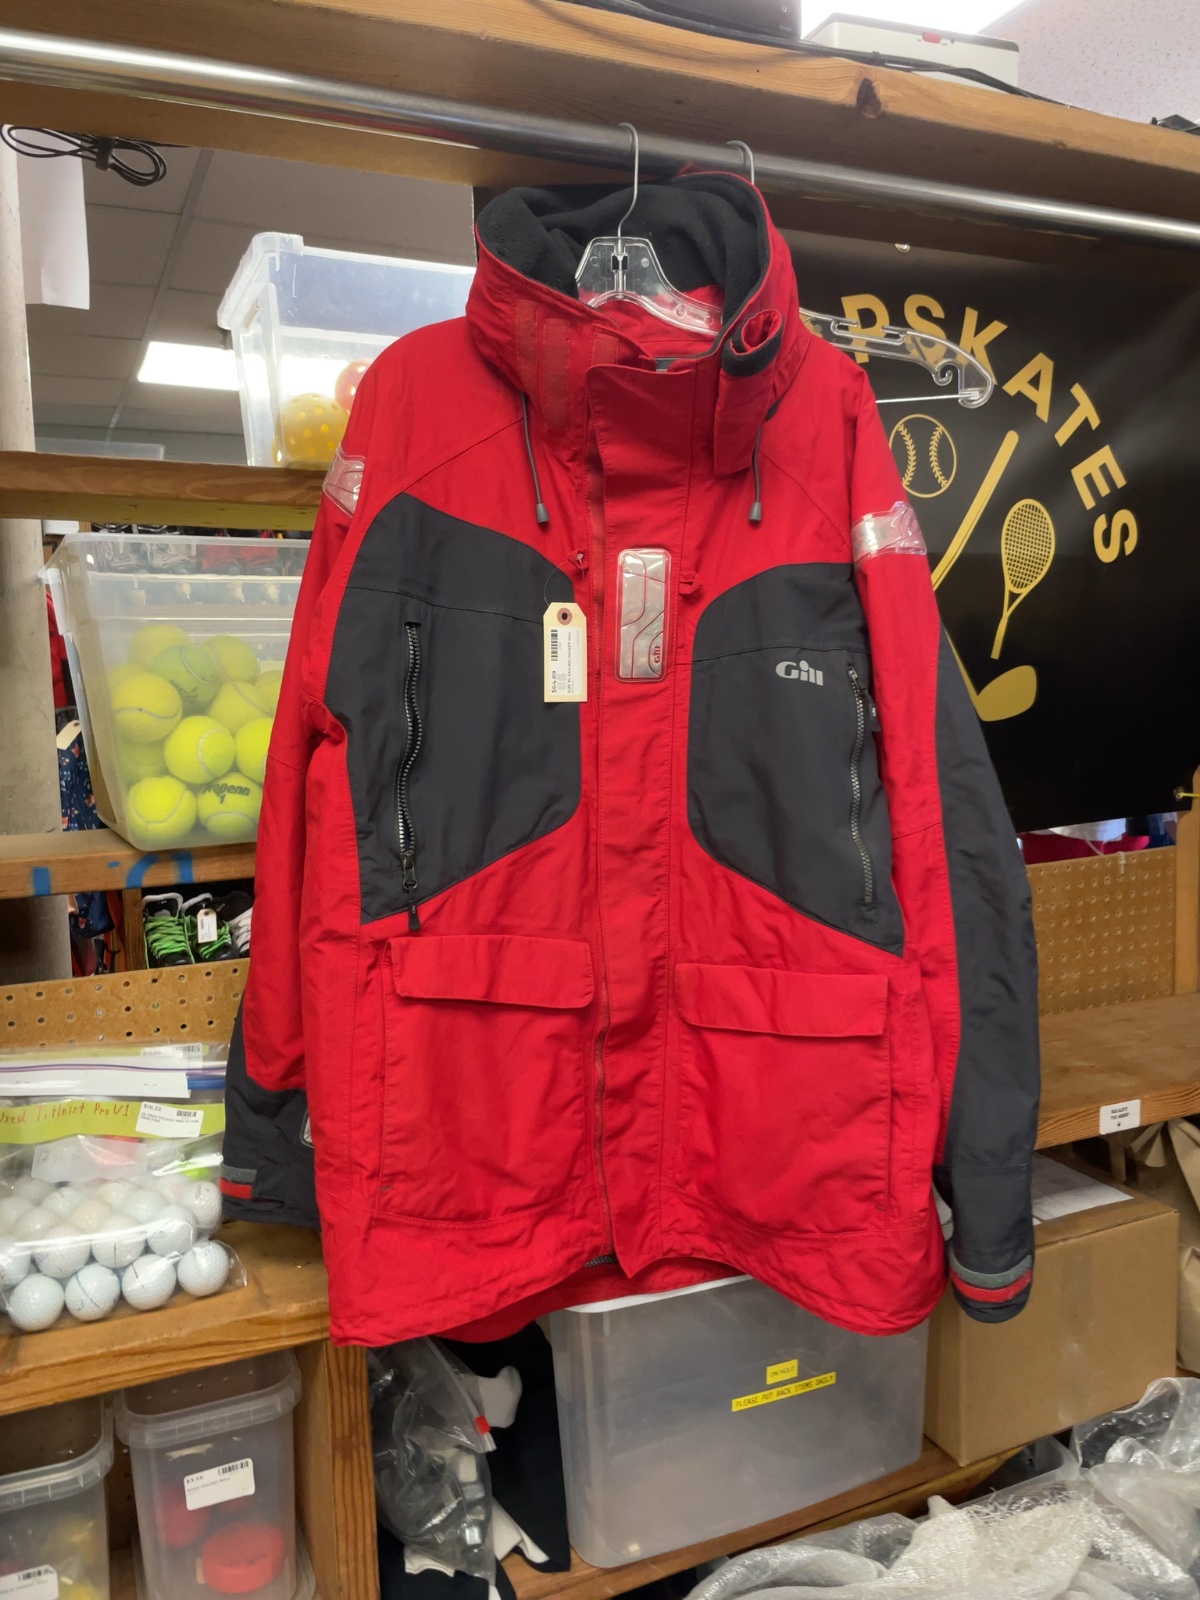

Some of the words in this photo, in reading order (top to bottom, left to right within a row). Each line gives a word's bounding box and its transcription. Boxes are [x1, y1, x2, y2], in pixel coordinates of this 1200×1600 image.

[800, 294, 1138, 563] PSKATES
[653, 645, 661, 663] Gill
[775, 660, 824, 686] Gill
[219, 794, 226, 805] 1
[735, 1396, 758, 1408] PLEASE
[762, 1392, 774, 1401] PUT
[776, 1387, 791, 1397] BACK
[795, 1381, 813, 1392] ITEMS
